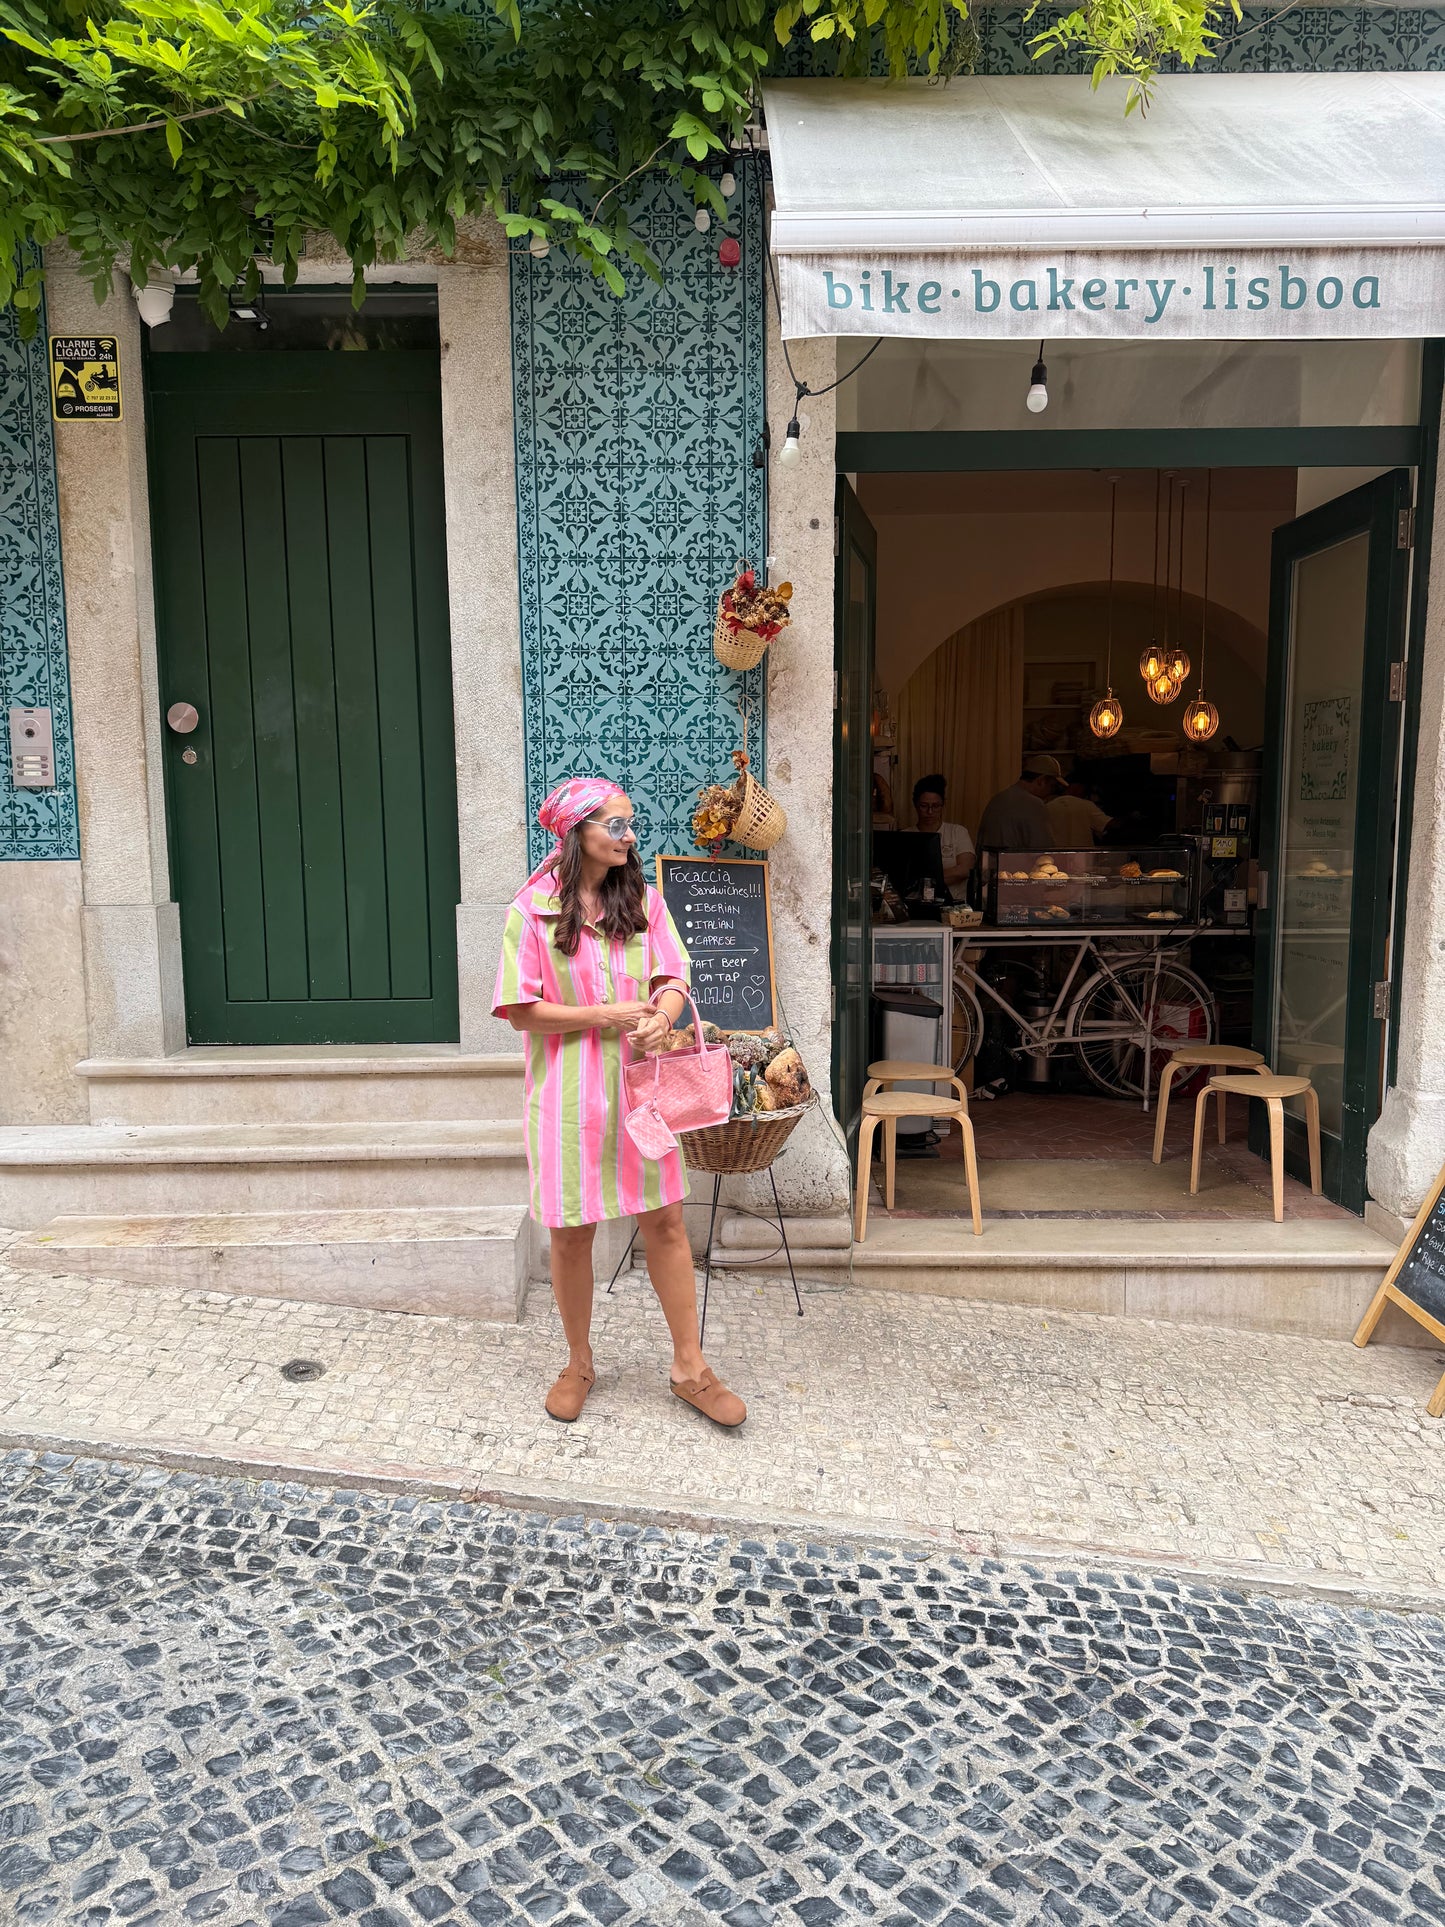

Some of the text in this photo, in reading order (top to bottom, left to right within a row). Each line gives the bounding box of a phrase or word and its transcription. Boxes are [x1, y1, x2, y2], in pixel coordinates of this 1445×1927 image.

[56, 348, 97, 357] LIGADO
[1317, 724, 1335, 737] bike
[1311, 739, 1339, 753] bakery
[669, 866, 735, 884] Focaccia
[694, 935, 736, 946] CAPRESE
